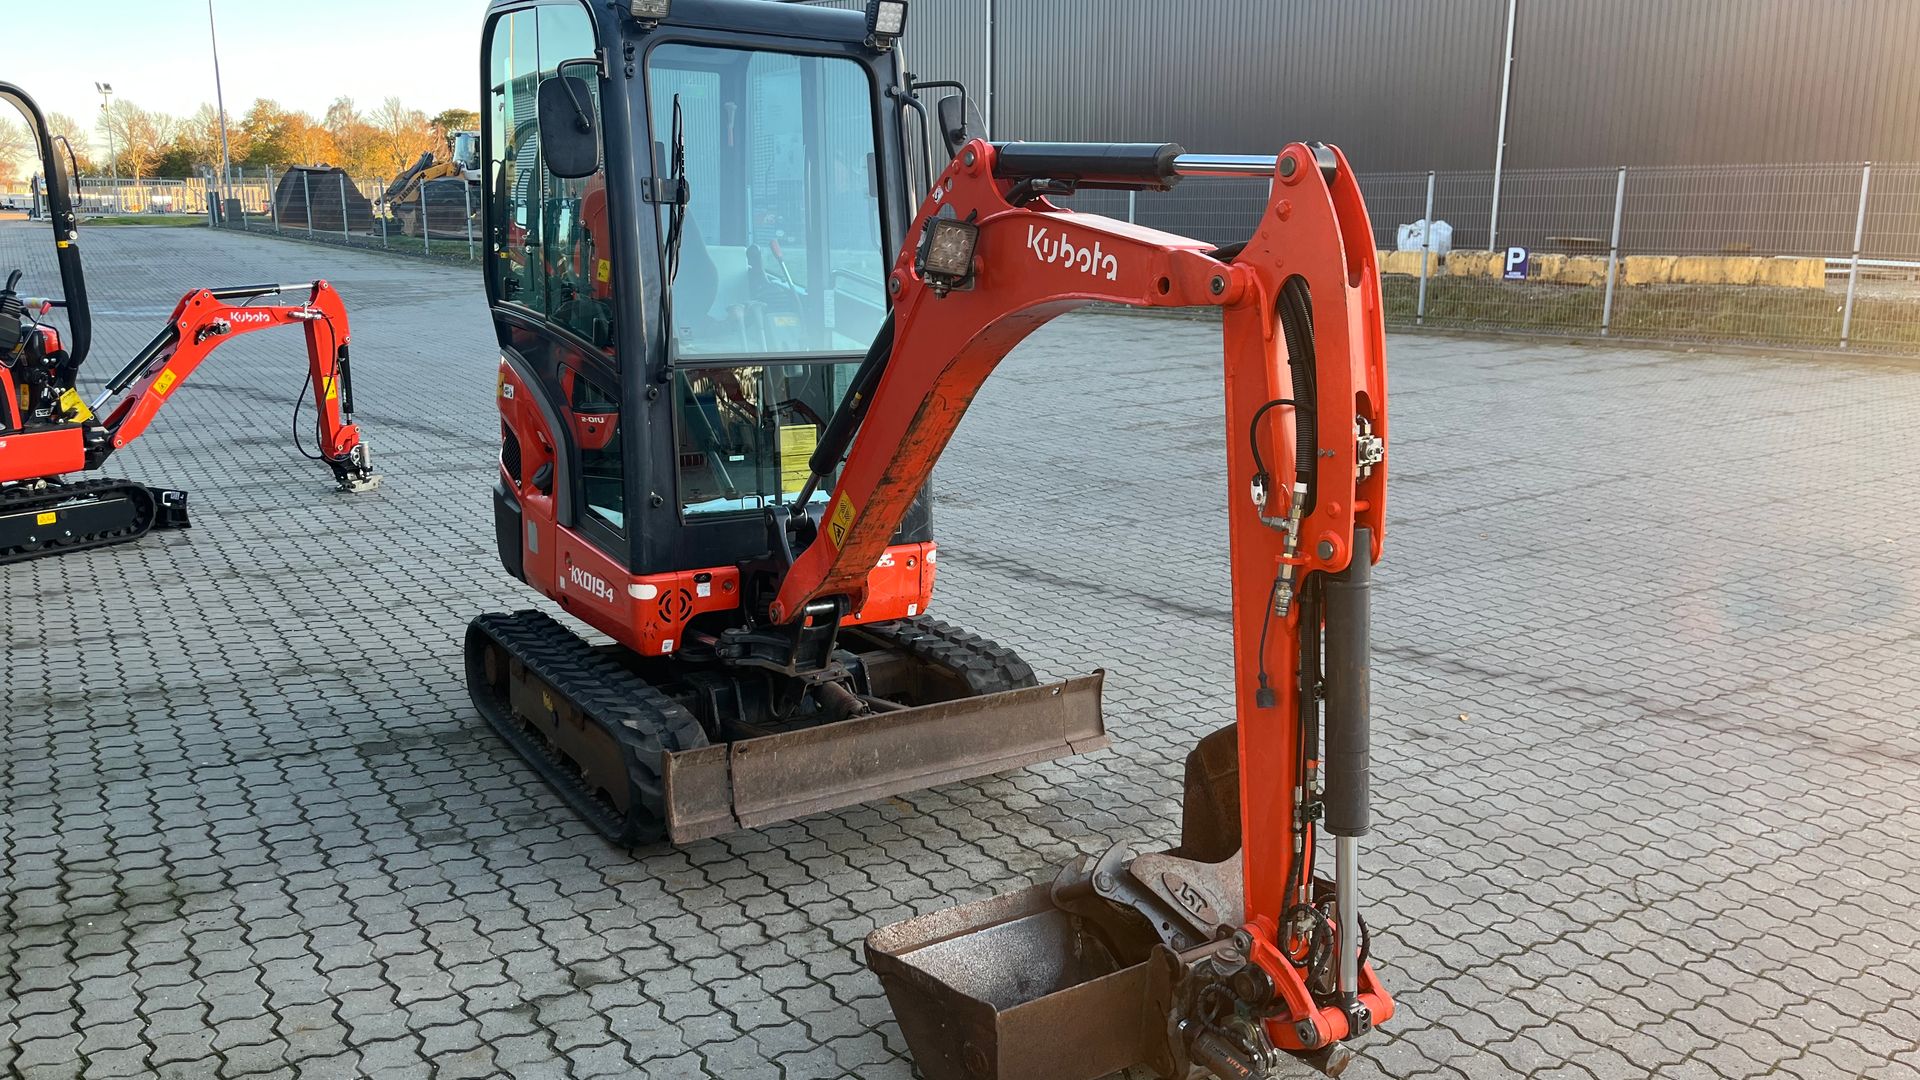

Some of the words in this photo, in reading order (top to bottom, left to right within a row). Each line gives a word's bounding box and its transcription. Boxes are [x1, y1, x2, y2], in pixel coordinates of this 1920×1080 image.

[1027, 224, 1117, 281] Kubota
[1506, 247, 1526, 271] P
[230, 311, 270, 322] Kubota
[571, 565, 614, 603] KX019-4
